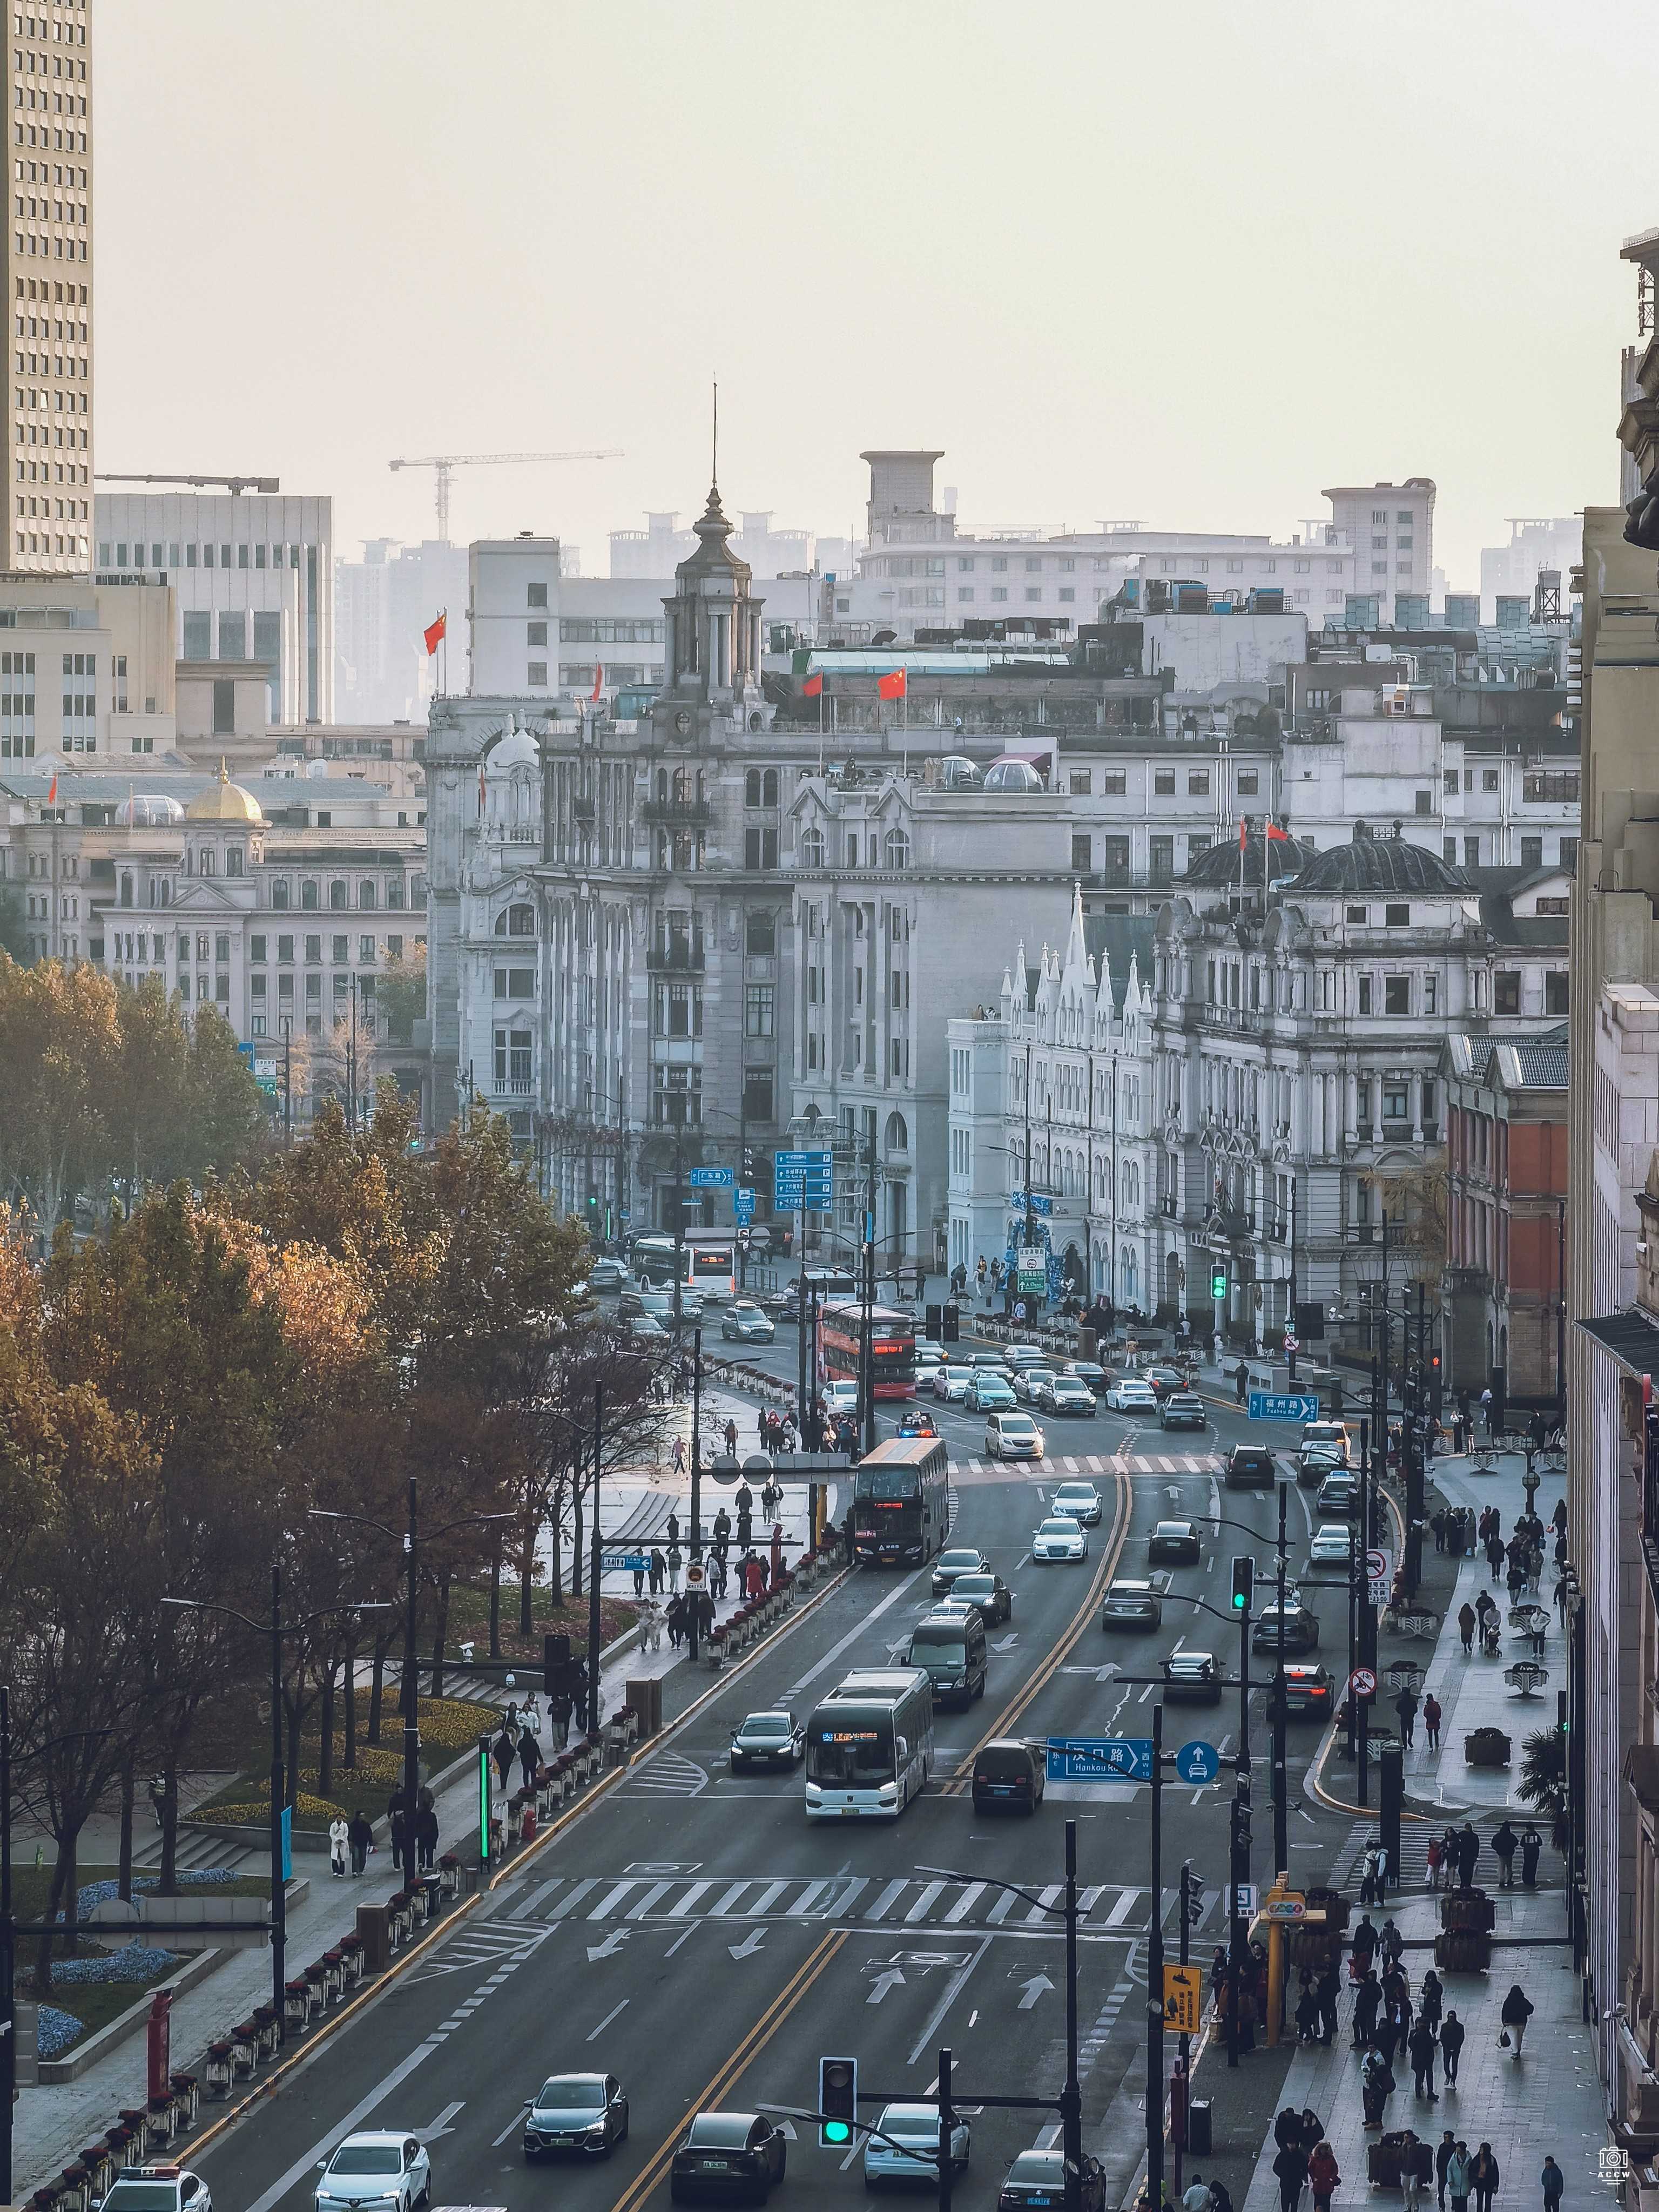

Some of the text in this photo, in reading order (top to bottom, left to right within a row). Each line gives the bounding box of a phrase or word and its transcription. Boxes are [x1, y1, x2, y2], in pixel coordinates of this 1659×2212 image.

[1266, 1399, 1298, 1409] 福州路
[1072, 1747, 1124, 1762] 汉口路
[1075, 1763, 1106, 1771] Hankou
